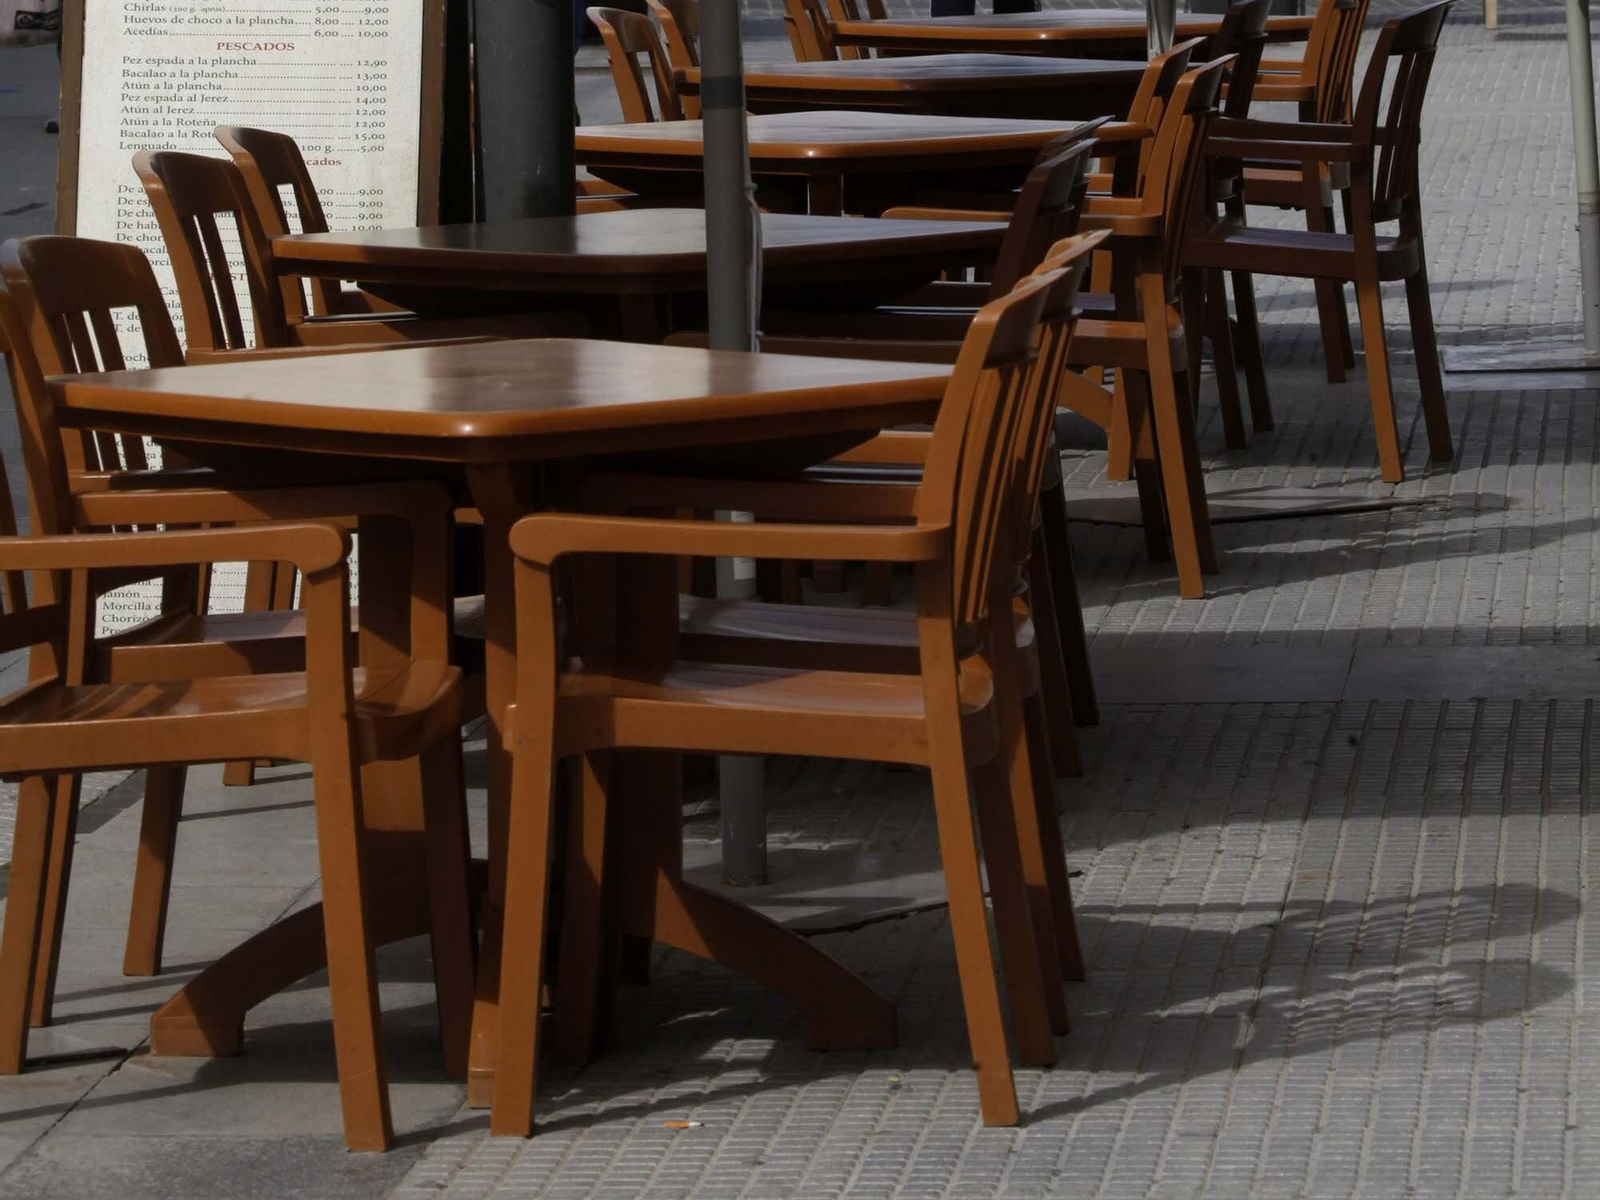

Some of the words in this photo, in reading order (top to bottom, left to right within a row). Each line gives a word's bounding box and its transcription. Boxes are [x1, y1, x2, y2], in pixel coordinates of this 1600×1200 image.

[124, 27, 168, 35] Acedías
[313, 29, 339, 37] 6,00
[217, 42, 295, 51] PESCADOS
[120, 93, 141, 101] Pez
[142, 93, 183, 104] espada
[186, 93, 197, 102] al
[200, 93, 229, 102] Jerez
[355, 97, 387, 105] 14,00
[121, 105, 149, 113] Atún
[153, 105, 163, 113] al
[166, 105, 194, 114] Jerez
[119, 141, 177, 152] Lenguado
[301, 144, 322, 152] 100
[360, 144, 386, 153] 5,00
[359, 188, 384, 197] 9,00
[358, 200, 384, 209] 9,00
[358, 212, 383, 221] 9,00
[102, 601, 151, 611] Morcilla
